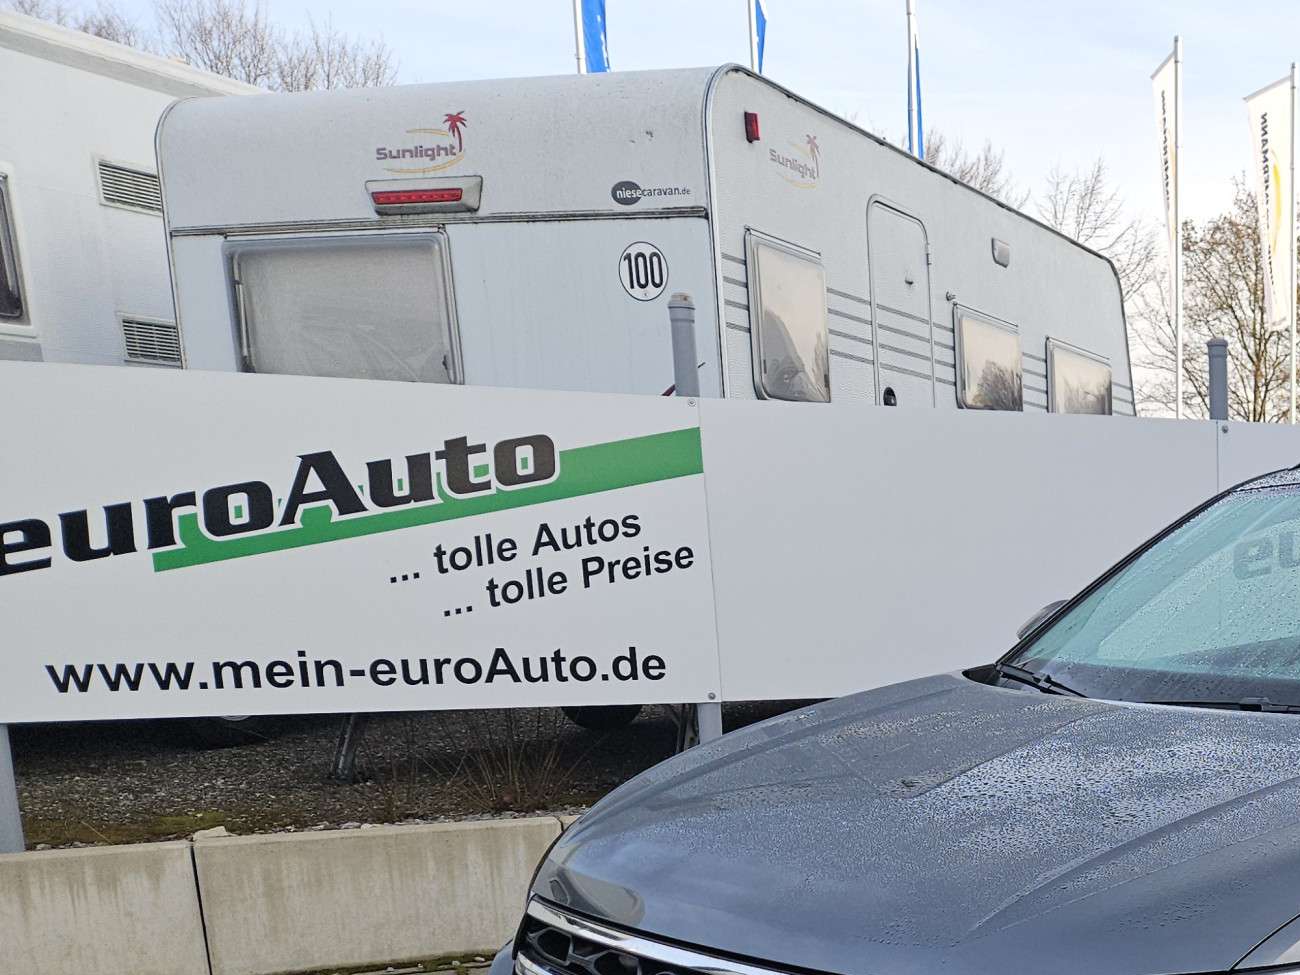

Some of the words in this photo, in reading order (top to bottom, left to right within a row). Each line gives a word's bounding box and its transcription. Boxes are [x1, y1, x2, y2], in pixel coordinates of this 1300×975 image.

[375, 144, 457, 162] Sunlight
[768, 148, 818, 179] Sunlight
[623, 251, 664, 290] 100
[0, 433, 556, 577] euroAuto
[433, 533, 518, 575] tolle
[531, 513, 642, 556] Autos
[485, 566, 569, 608] tolle
[580, 545, 695, 589] Preise
[45, 645, 667, 693] www.mein-euroAuto.de
